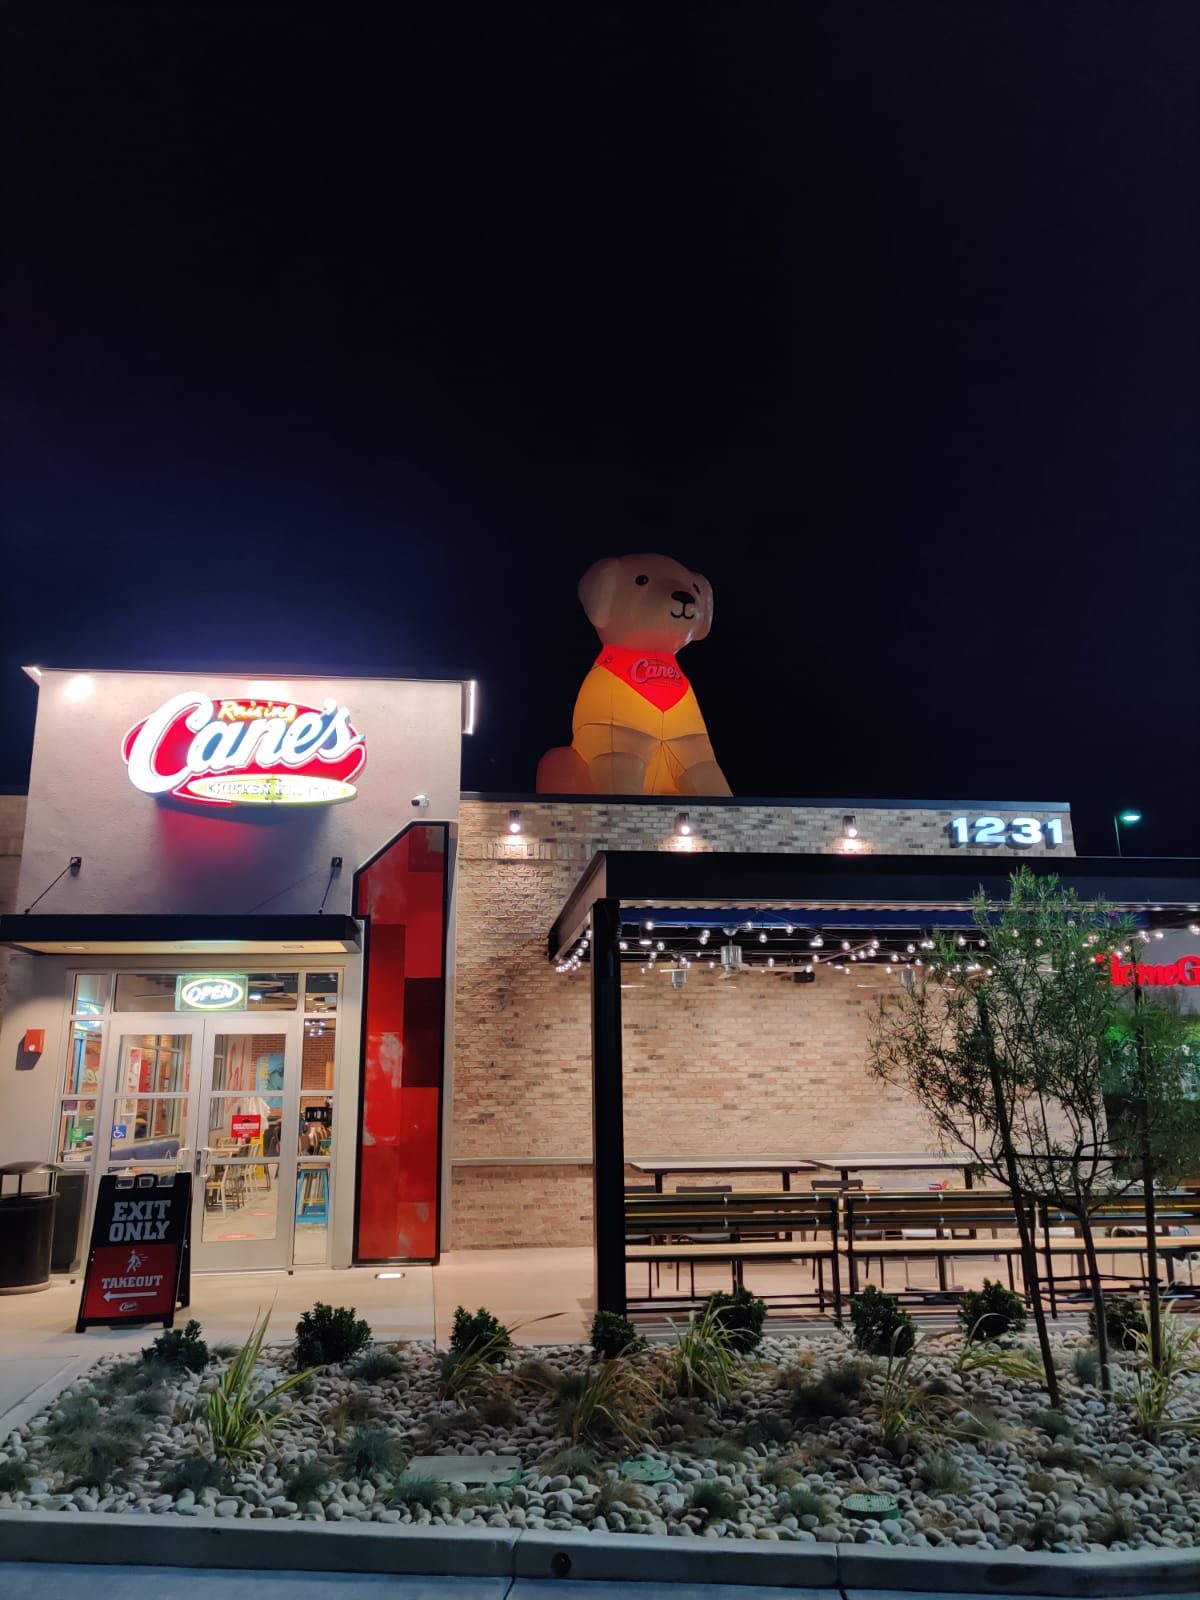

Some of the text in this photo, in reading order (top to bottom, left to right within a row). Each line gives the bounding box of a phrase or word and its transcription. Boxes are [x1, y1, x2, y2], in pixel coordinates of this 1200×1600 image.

[217, 701, 298, 724] Raising
[127, 691, 366, 793] Cane's
[951, 816, 1064, 846] 1231
[187, 984, 235, 1002] OPEN
[111, 1199, 172, 1222] EXIT
[108, 1220, 171, 1242] ONLY
[101, 1274, 164, 1290] TAKEOUT
